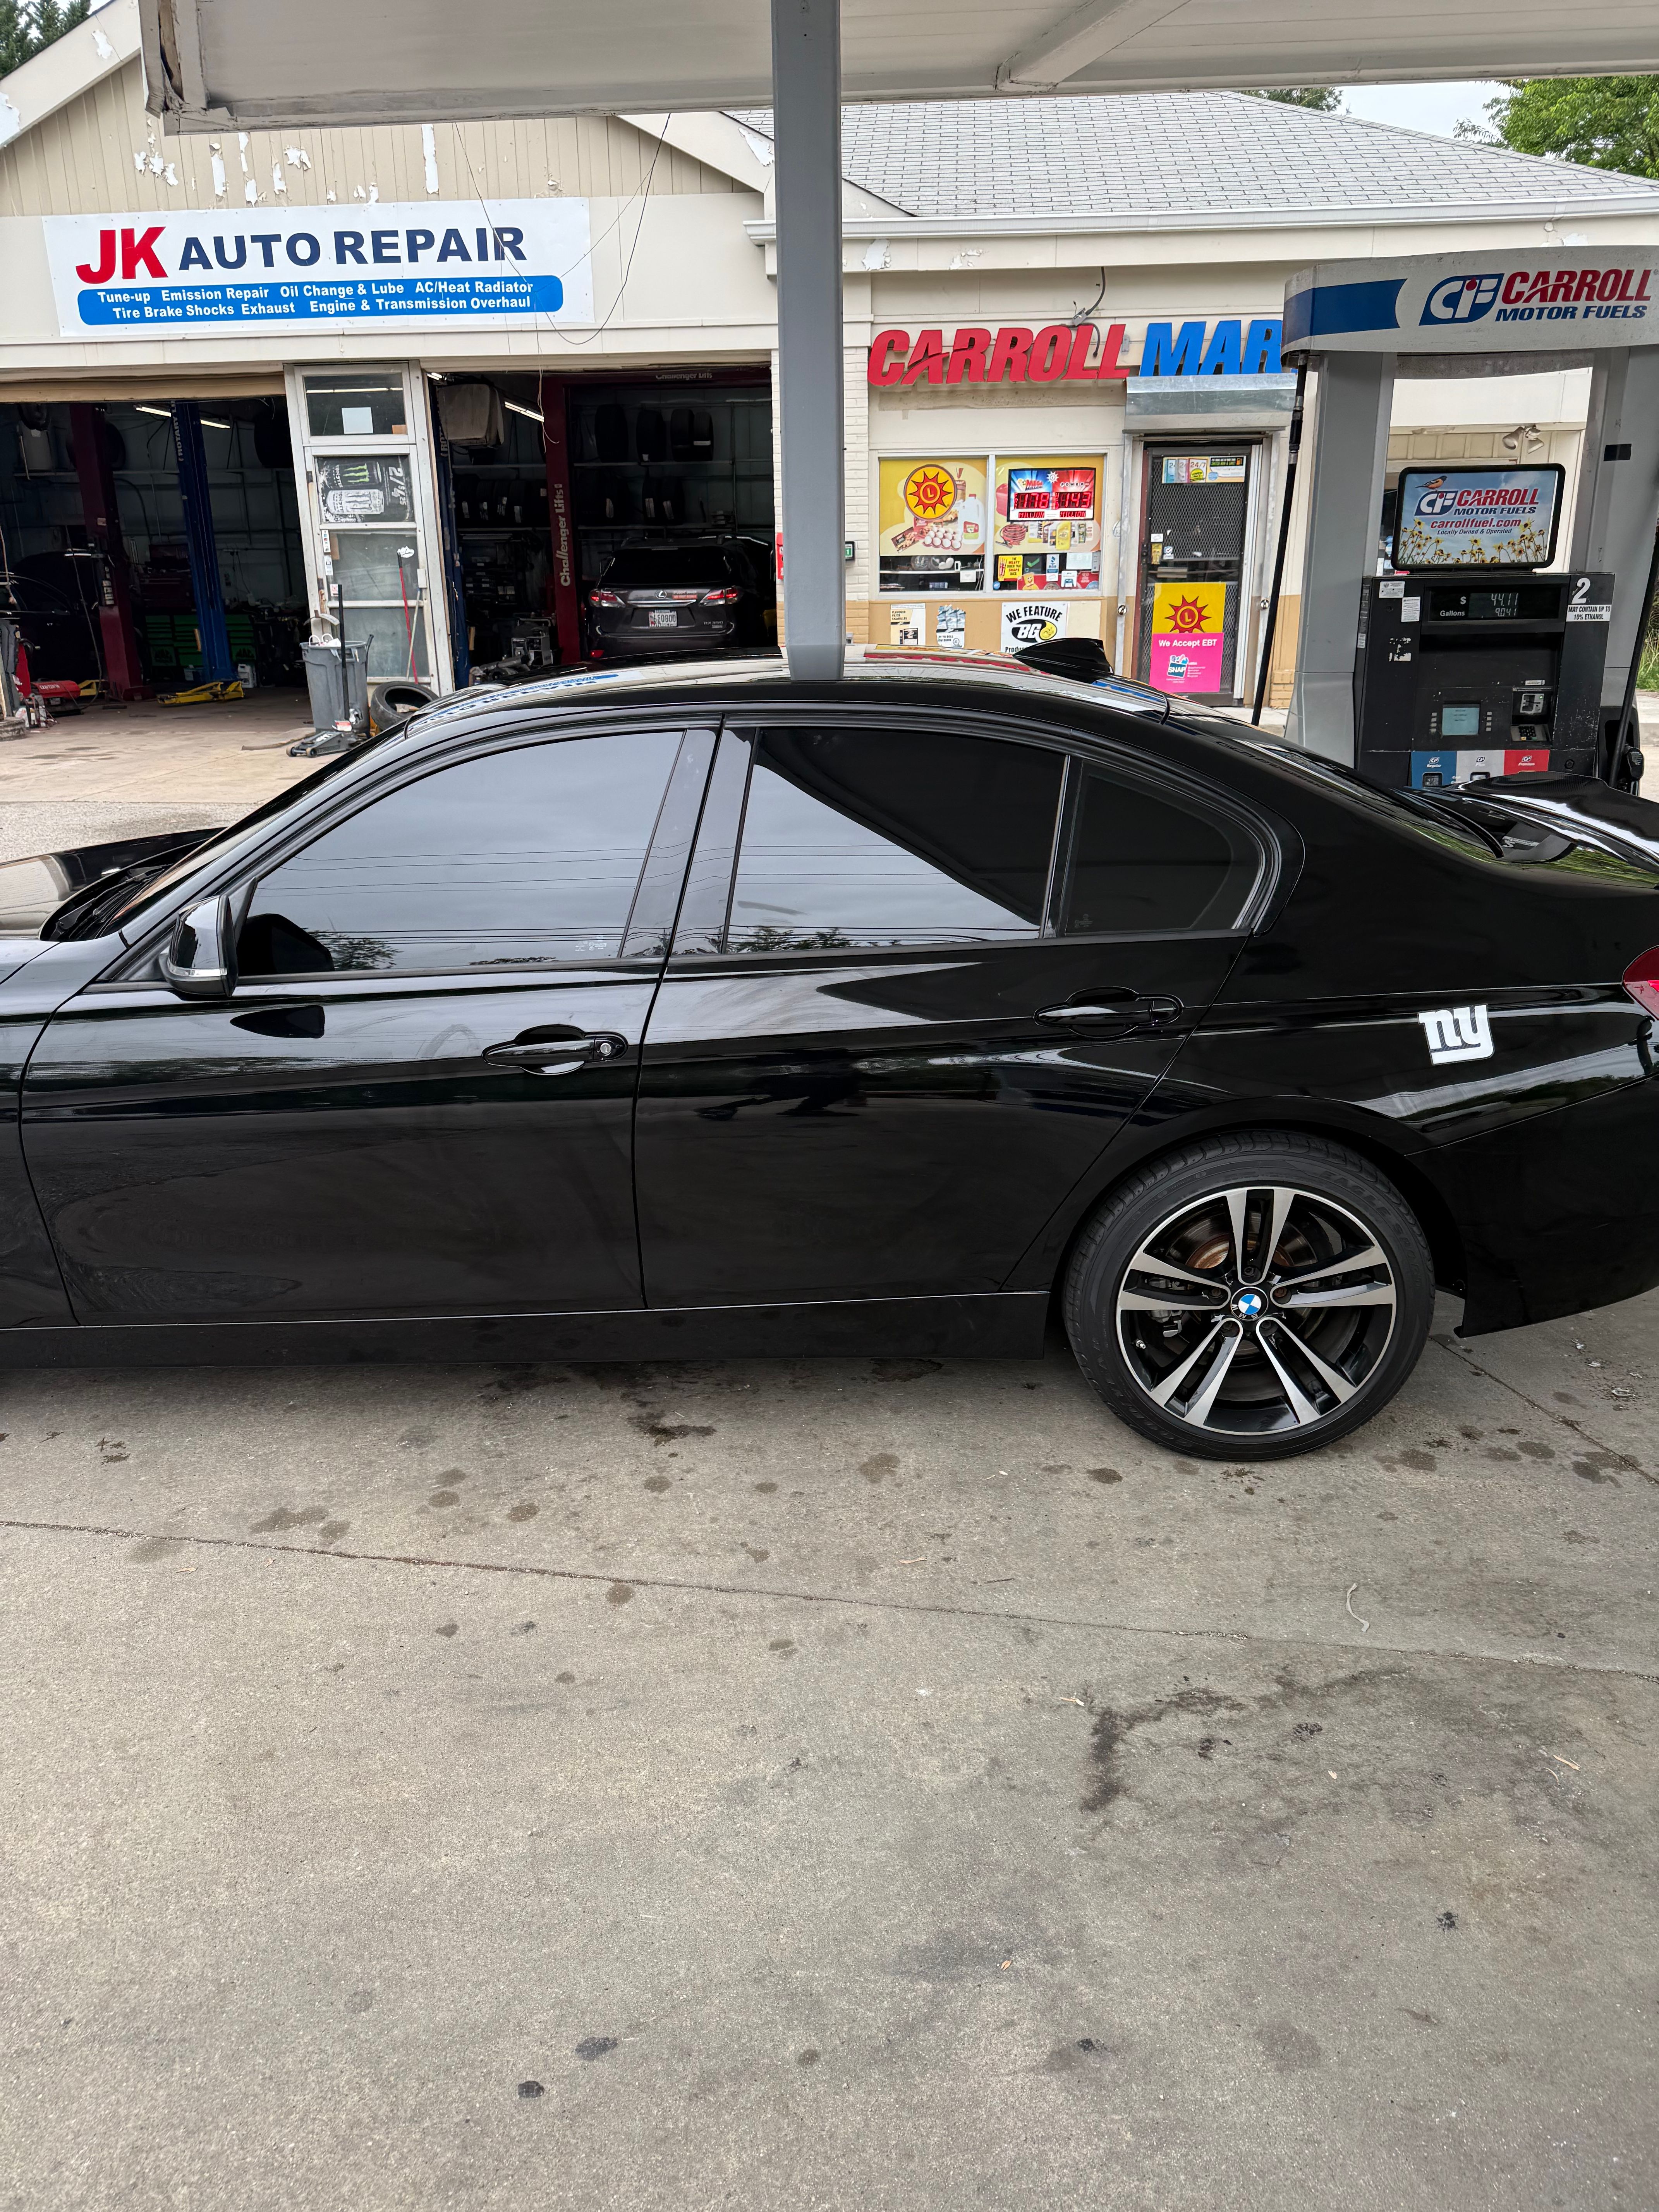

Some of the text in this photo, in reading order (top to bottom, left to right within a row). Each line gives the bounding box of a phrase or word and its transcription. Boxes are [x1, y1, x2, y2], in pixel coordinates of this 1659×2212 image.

[76, 226, 527, 284] JK AUTO REPAIR
[97, 280, 533, 304] Tune-up Emission Repair Oil Change & Lube AC/Heat Radiator
[1501, 268, 1653, 304] CARROLL
[112, 296, 531, 319] Tire Brake Shocks Exhaust Engine & Transmission Overhaul
[1495, 305, 1647, 322] MOTOR FUELS
[867, 319, 1283, 386] CARROLL MAR
[1024, 493, 1049, 508] 178
[1065, 492, 1092, 508] 143
[1456, 488, 1539, 507] CARROLL
[1454, 506, 1537, 516] MOTOR FUELS
[1431, 517, 1522, 529] carrollfuel.com
[1486, 527, 1512, 535] Operated
[553, 489, 571, 587] Challenger Lifts
[1571, 578, 1590, 604] 2
[1460, 596, 1467, 605] $
[1006, 606, 1063, 623] WE FEATURE
[1014, 623, 1042, 640] BG
[1172, 639, 1200, 648] Accept
[1231, 1304, 1258, 1319] BMW
